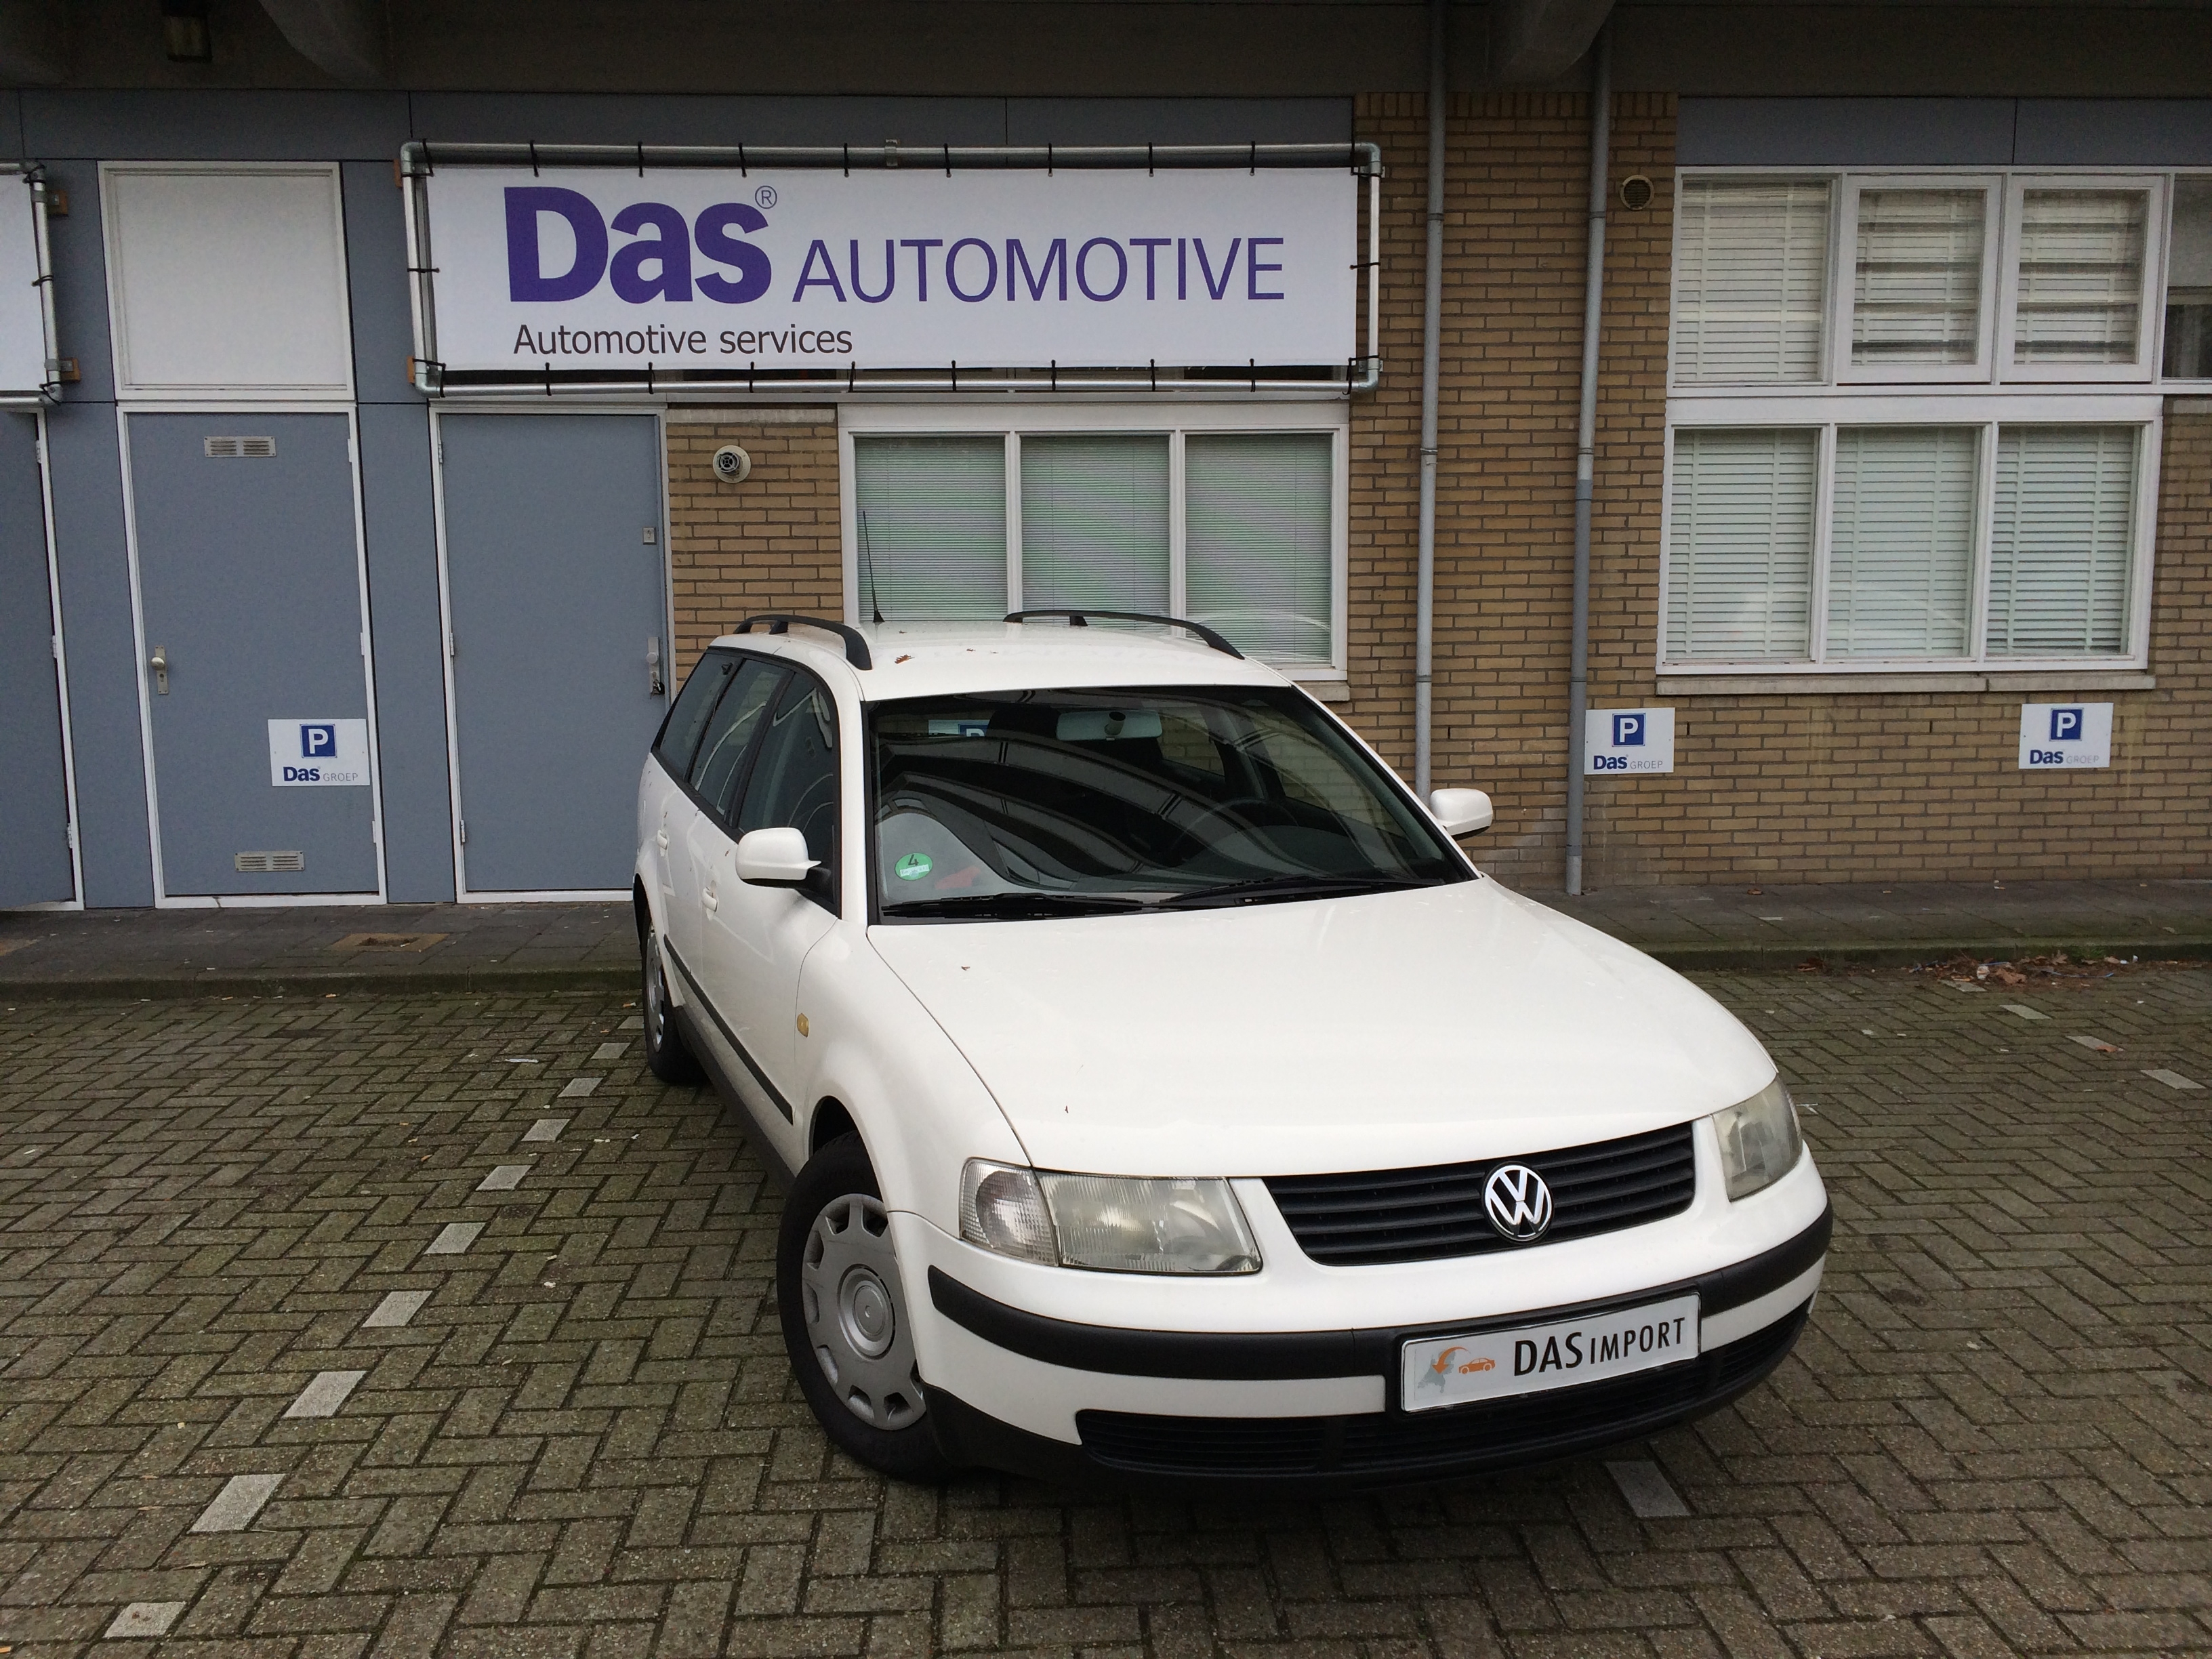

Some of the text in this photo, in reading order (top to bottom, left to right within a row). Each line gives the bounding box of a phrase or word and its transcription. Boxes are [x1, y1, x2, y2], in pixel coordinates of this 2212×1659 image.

[792, 237, 1285, 304] AUTOMOTIVE
[513, 323, 853, 354] Automotive services
[1619, 718, 1639, 743] P
[2056, 712, 2076, 737] P
[308, 729, 329, 754] P
[1630, 760, 1663, 770] GROEP
[2066, 755, 2100, 764] GROEP
[323, 773, 359, 781] GROEP
[908, 854, 919, 865] 4
